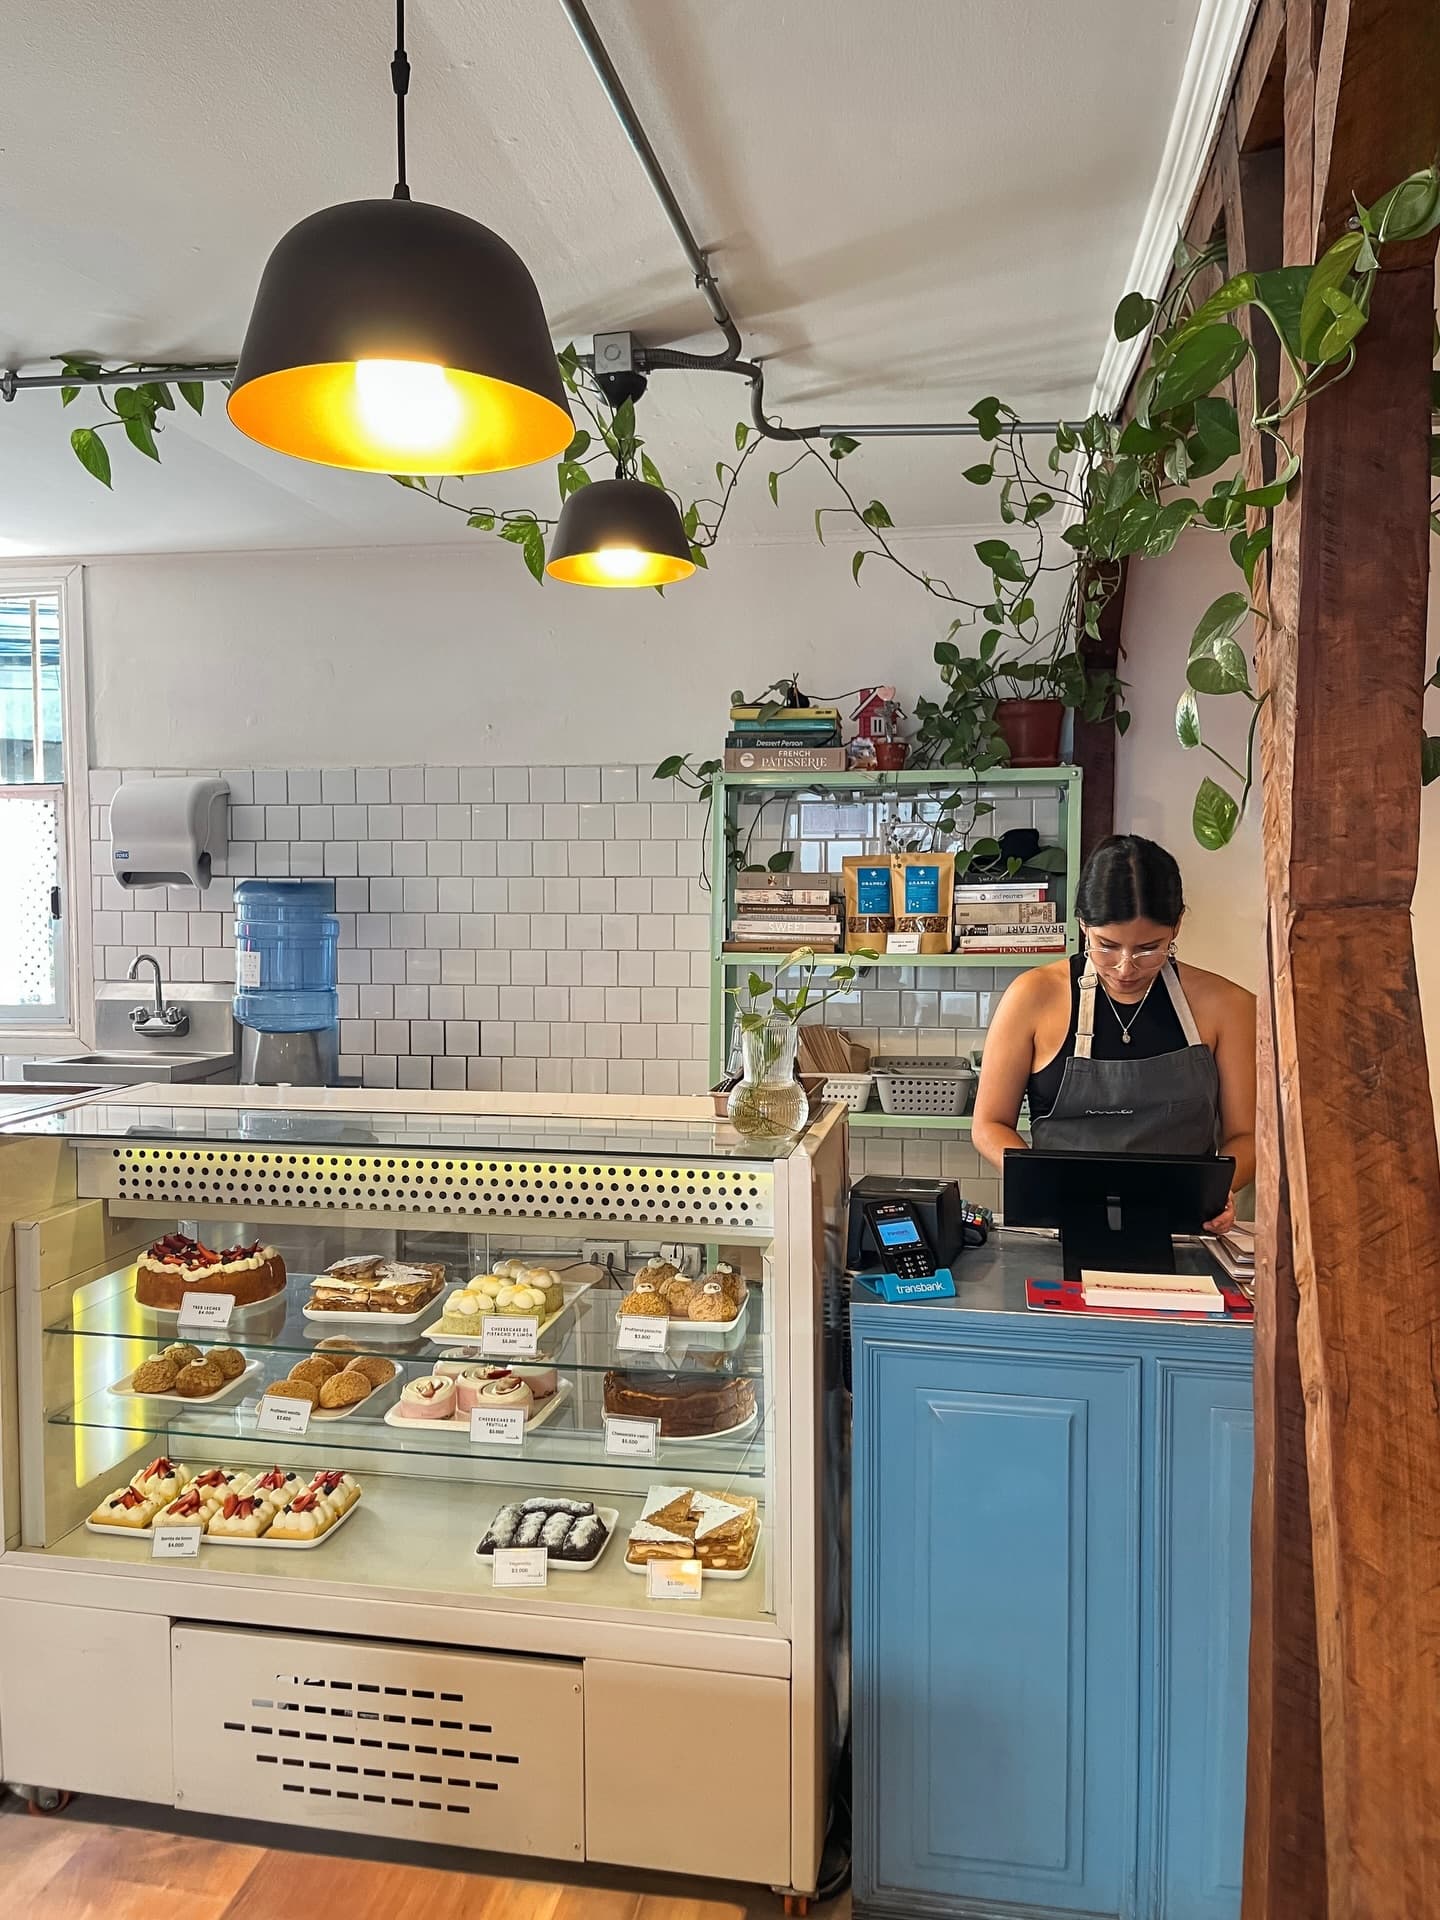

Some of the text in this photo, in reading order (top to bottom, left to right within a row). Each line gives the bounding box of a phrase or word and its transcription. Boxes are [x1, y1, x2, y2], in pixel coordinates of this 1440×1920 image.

[756, 739, 803, 747] Dessert Person
[768, 922, 808, 932] SWEET
[1007, 925, 1065, 933] BRAVETART
[896, 1281, 944, 1294] transbank
